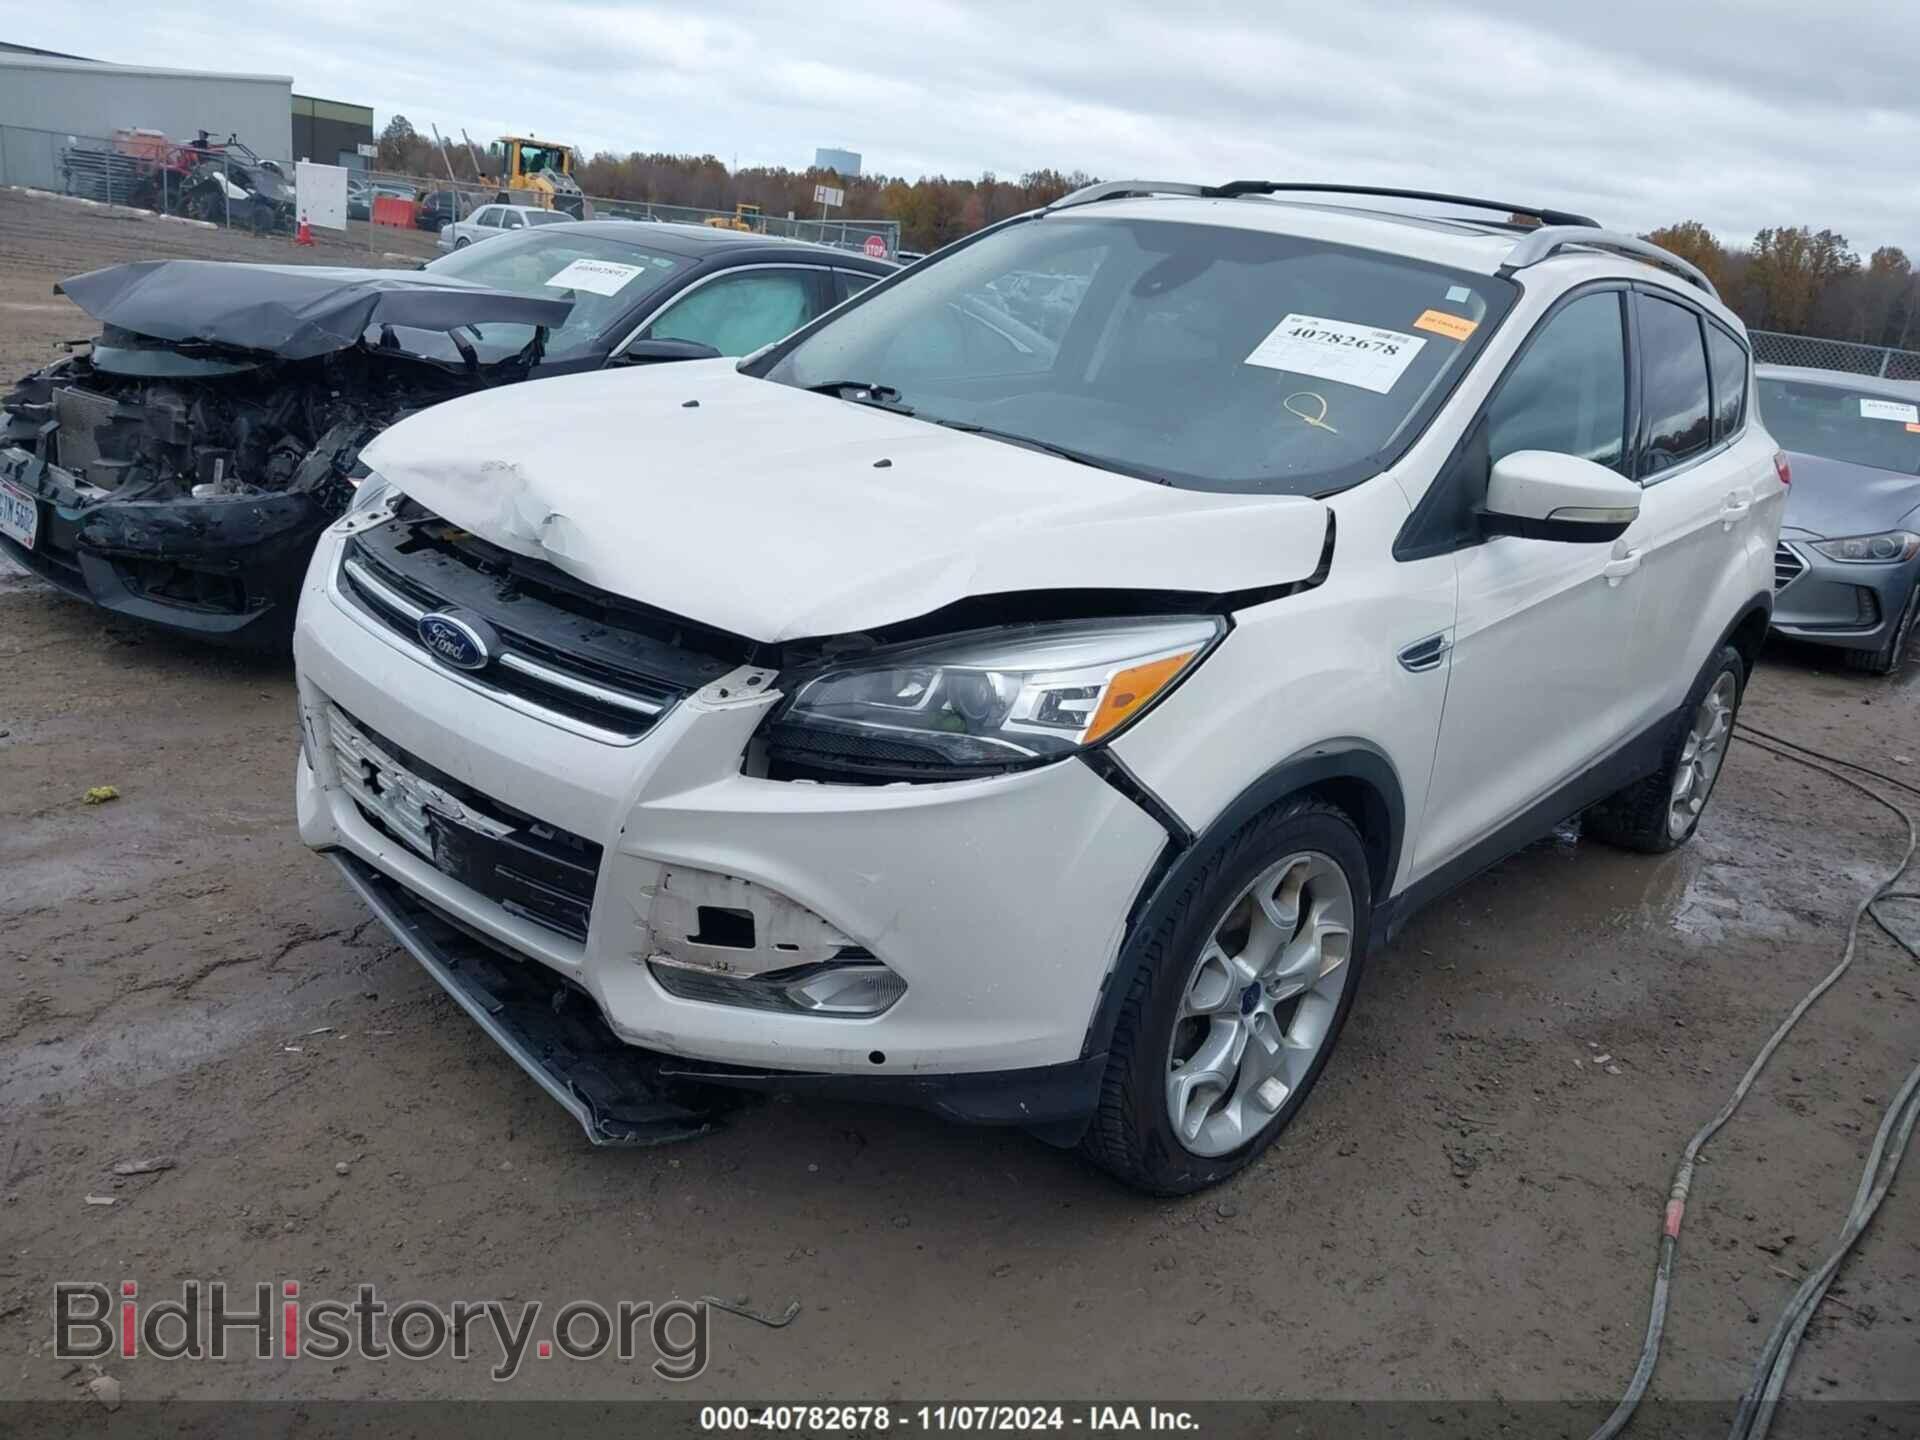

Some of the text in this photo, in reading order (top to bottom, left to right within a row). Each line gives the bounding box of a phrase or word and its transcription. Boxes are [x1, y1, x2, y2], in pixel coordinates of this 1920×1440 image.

[865, 243, 884, 257] STOP
[1288, 327, 1400, 356] 40782678
[427, 623, 465, 660] Ford
